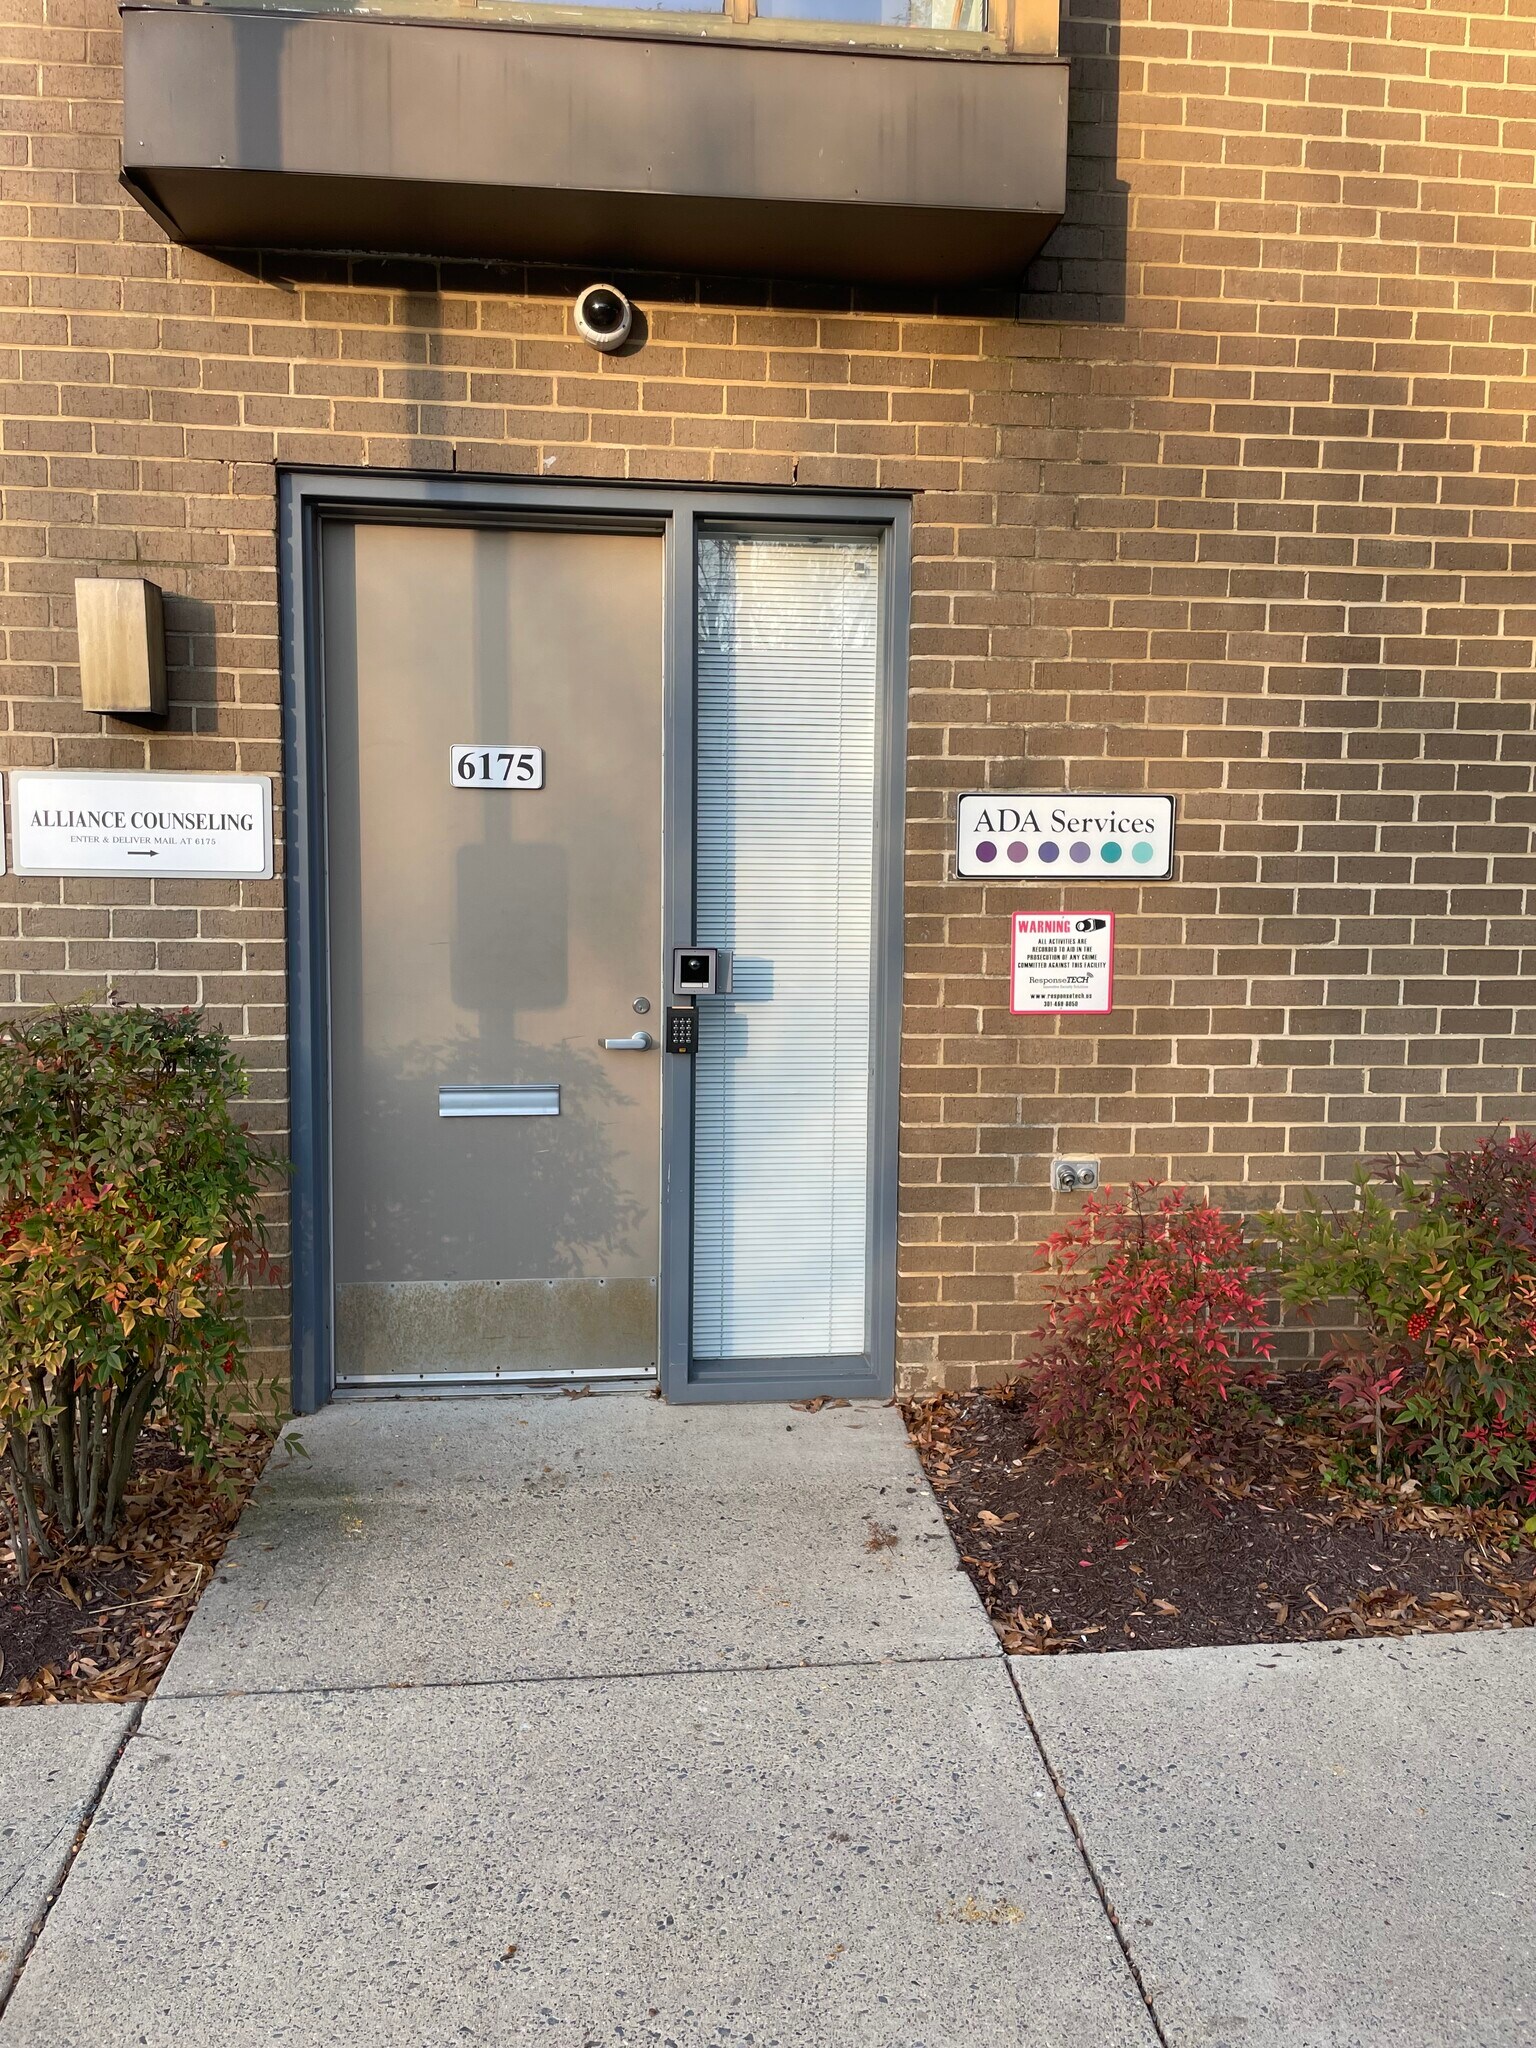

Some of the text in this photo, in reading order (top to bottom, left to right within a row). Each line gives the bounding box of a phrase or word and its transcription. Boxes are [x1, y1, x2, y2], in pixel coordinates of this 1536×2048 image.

[457, 752, 534, 781] 6175
[30, 809, 254, 832] ALLIANCE COUNSELING
[973, 808, 1155, 834] ADA Services
[70, 835, 217, 846] ENTER & DELIVER MAIL AT 6175
[1018, 920, 1071, 933] WARNING
[1029, 976, 1090, 985] ResponseTECH
